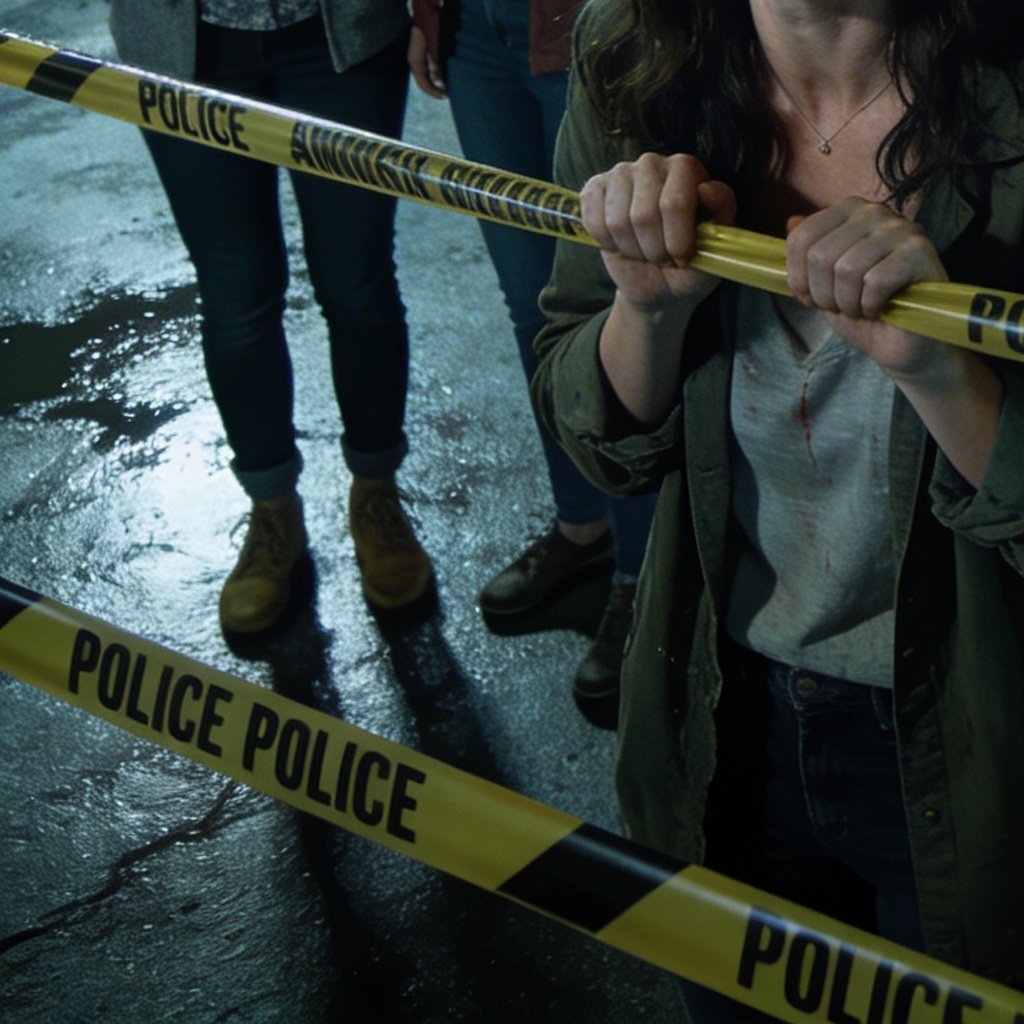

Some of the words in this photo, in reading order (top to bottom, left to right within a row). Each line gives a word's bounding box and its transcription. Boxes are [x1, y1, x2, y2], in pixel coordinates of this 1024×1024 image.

[138, 79, 249, 152] POLICE
[67, 628, 233, 757] POLICE
[242, 702, 427, 844] POLICE
